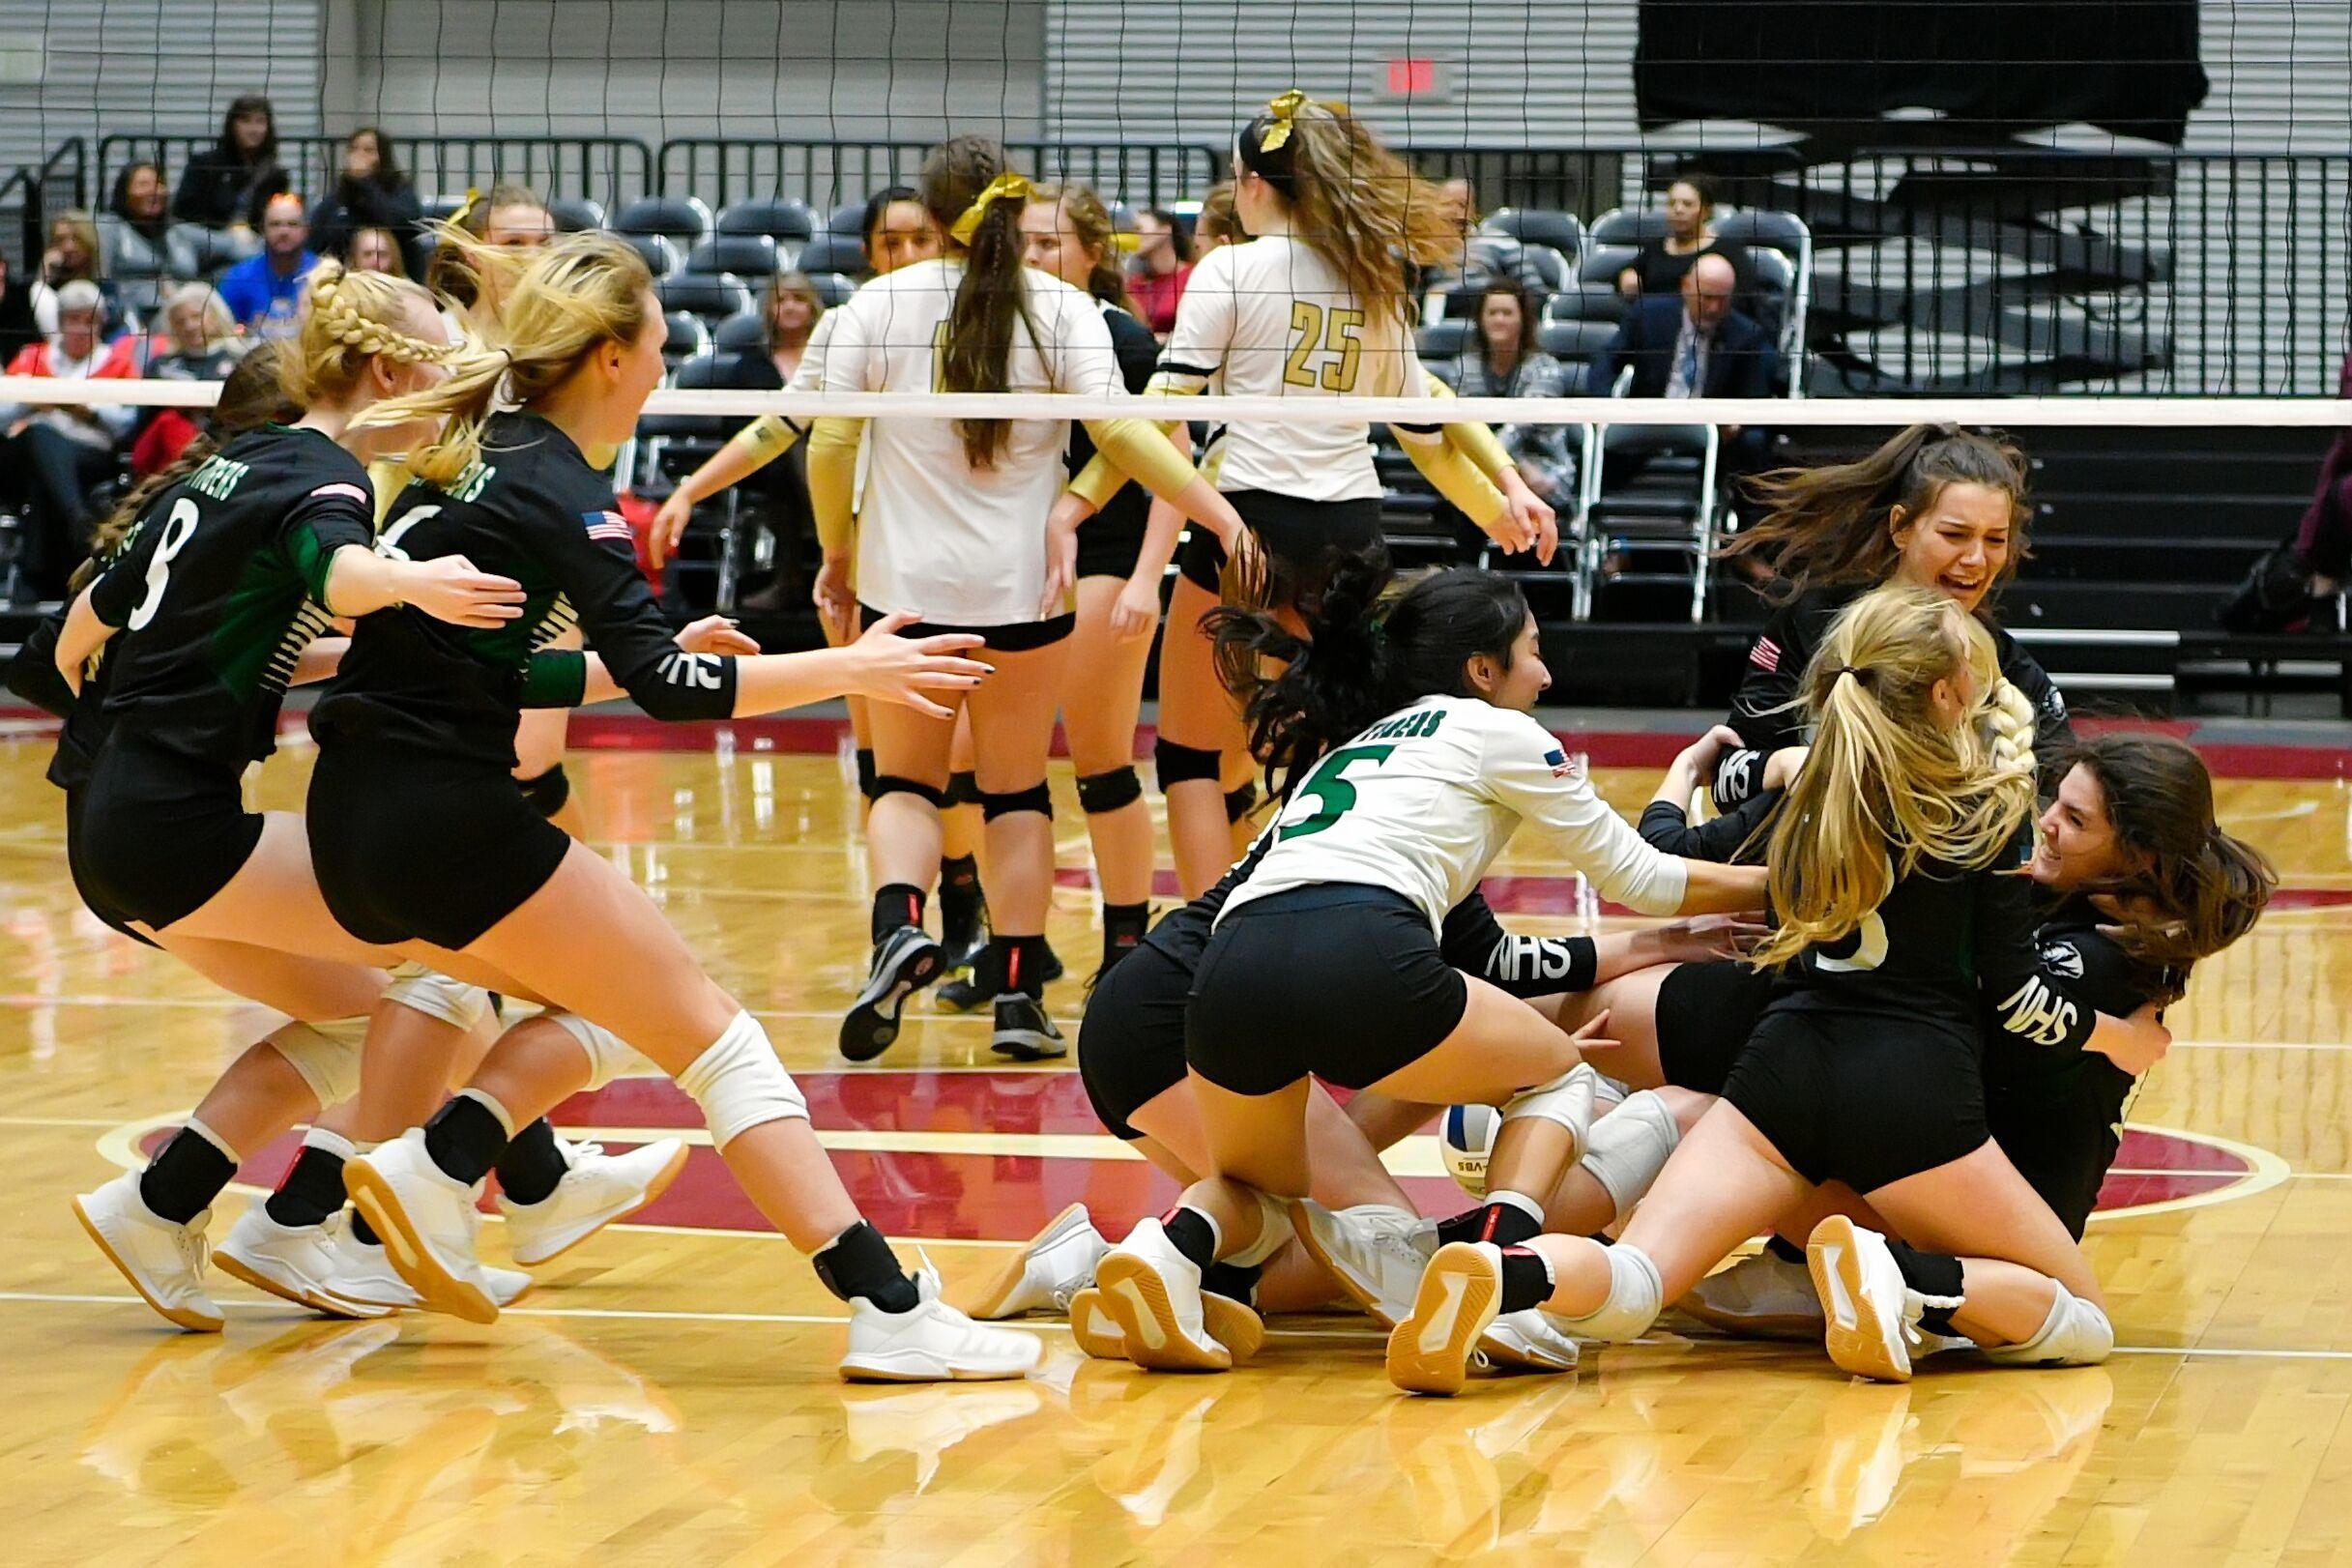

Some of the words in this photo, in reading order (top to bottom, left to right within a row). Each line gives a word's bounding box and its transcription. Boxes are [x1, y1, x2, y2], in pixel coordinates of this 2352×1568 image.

[1283, 300, 1365, 392] 25
[128, 497, 200, 631] 8
[1277, 743, 1400, 844] 5
[1483, 934, 1572, 980] NHS
[1996, 974, 2078, 1046] NHS
